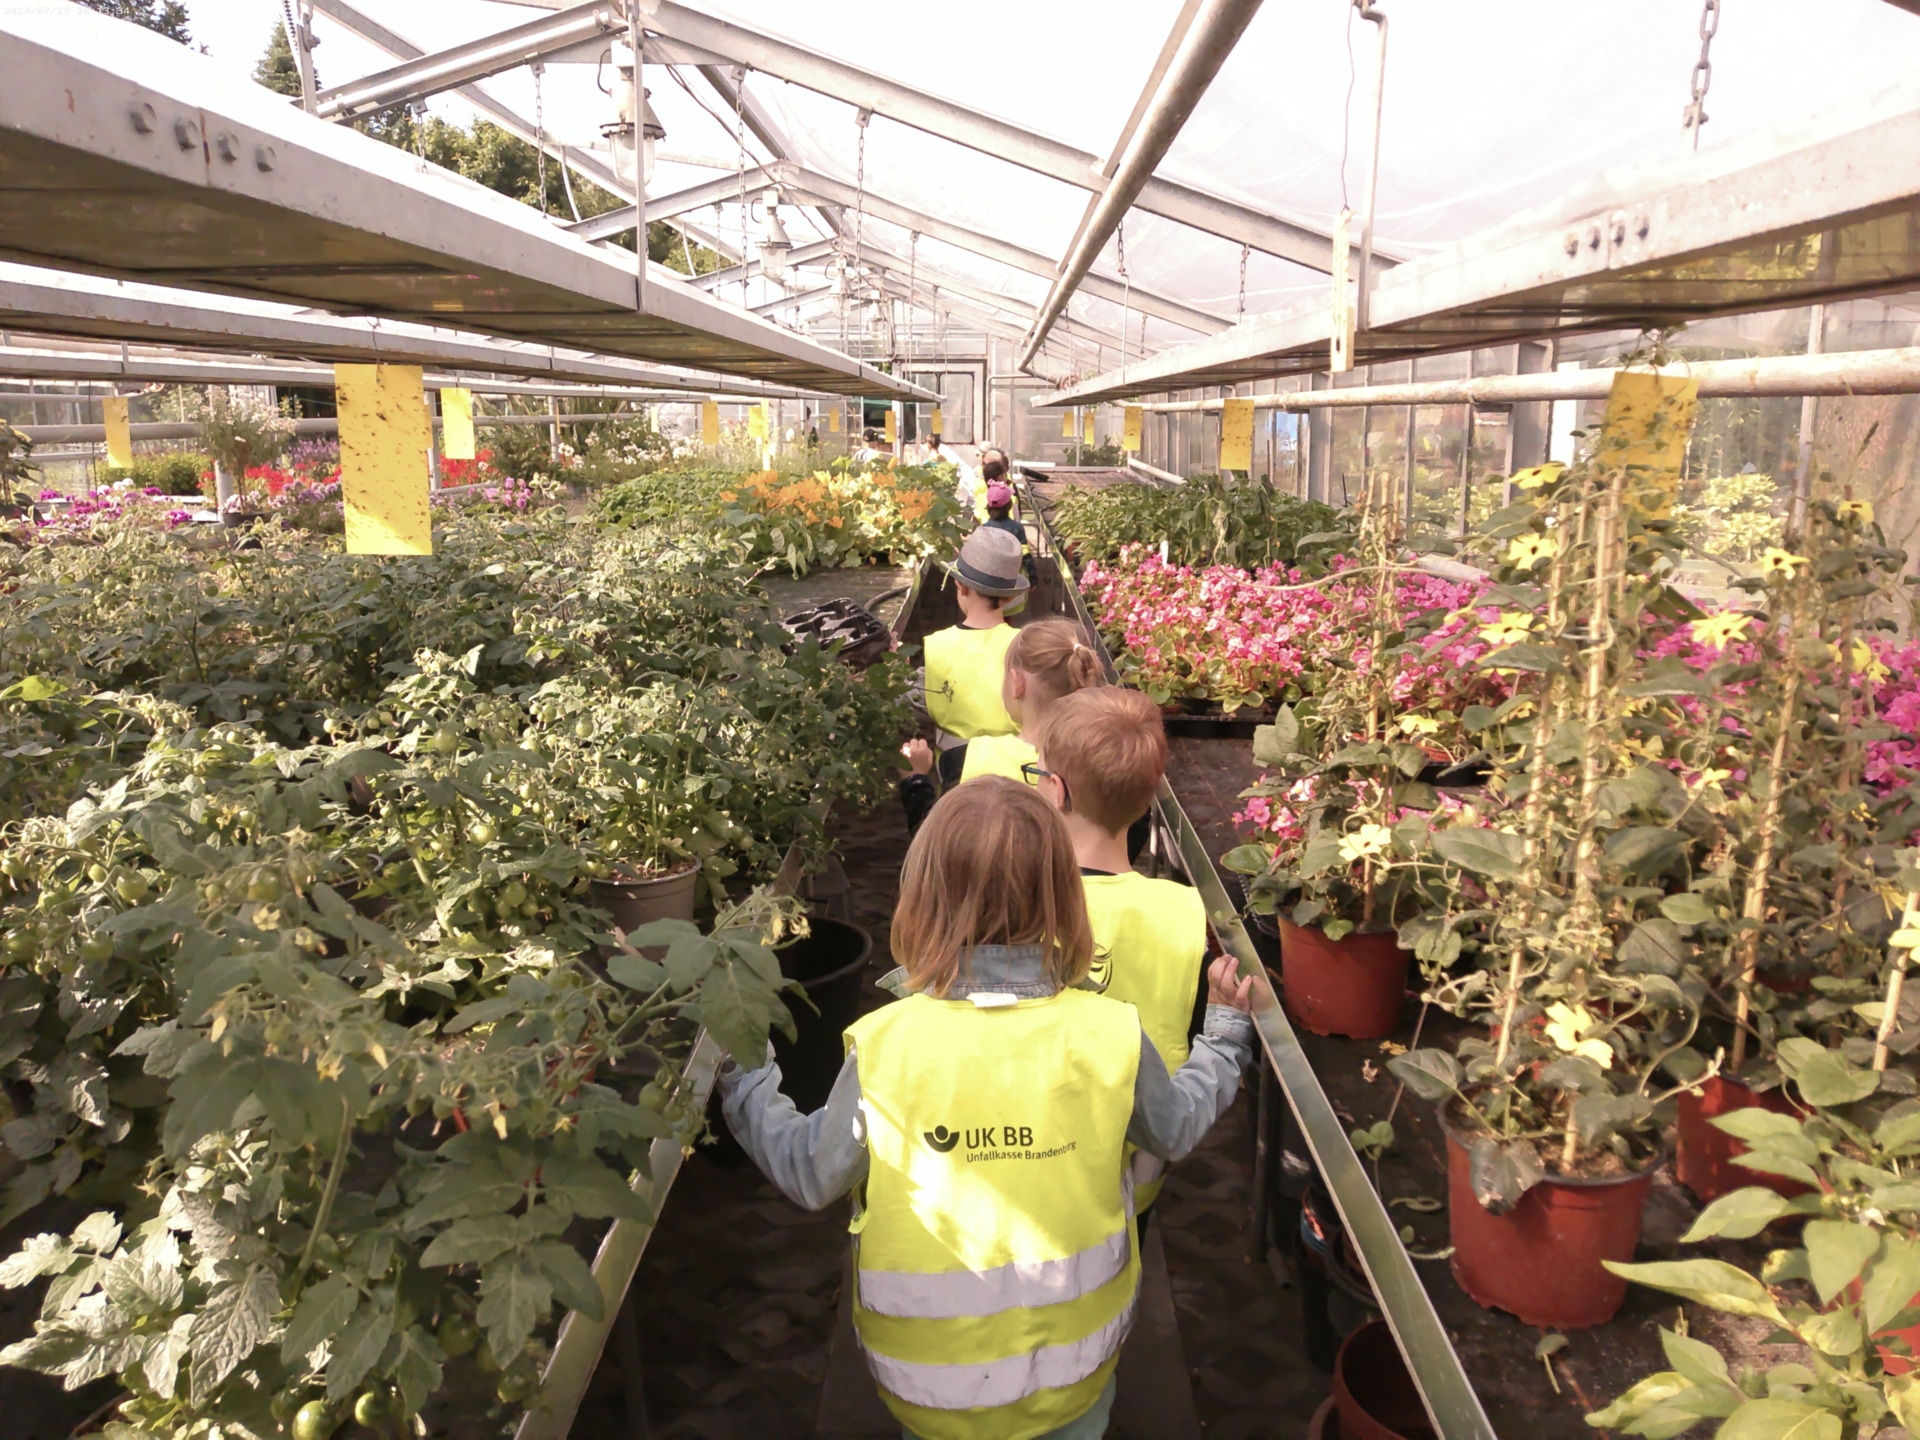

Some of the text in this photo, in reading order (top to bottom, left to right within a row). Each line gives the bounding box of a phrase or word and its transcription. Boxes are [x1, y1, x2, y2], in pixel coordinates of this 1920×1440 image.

[966, 1126, 1034, 1149] UK BB
[966, 1150, 1023, 1163] Unfallkasse
